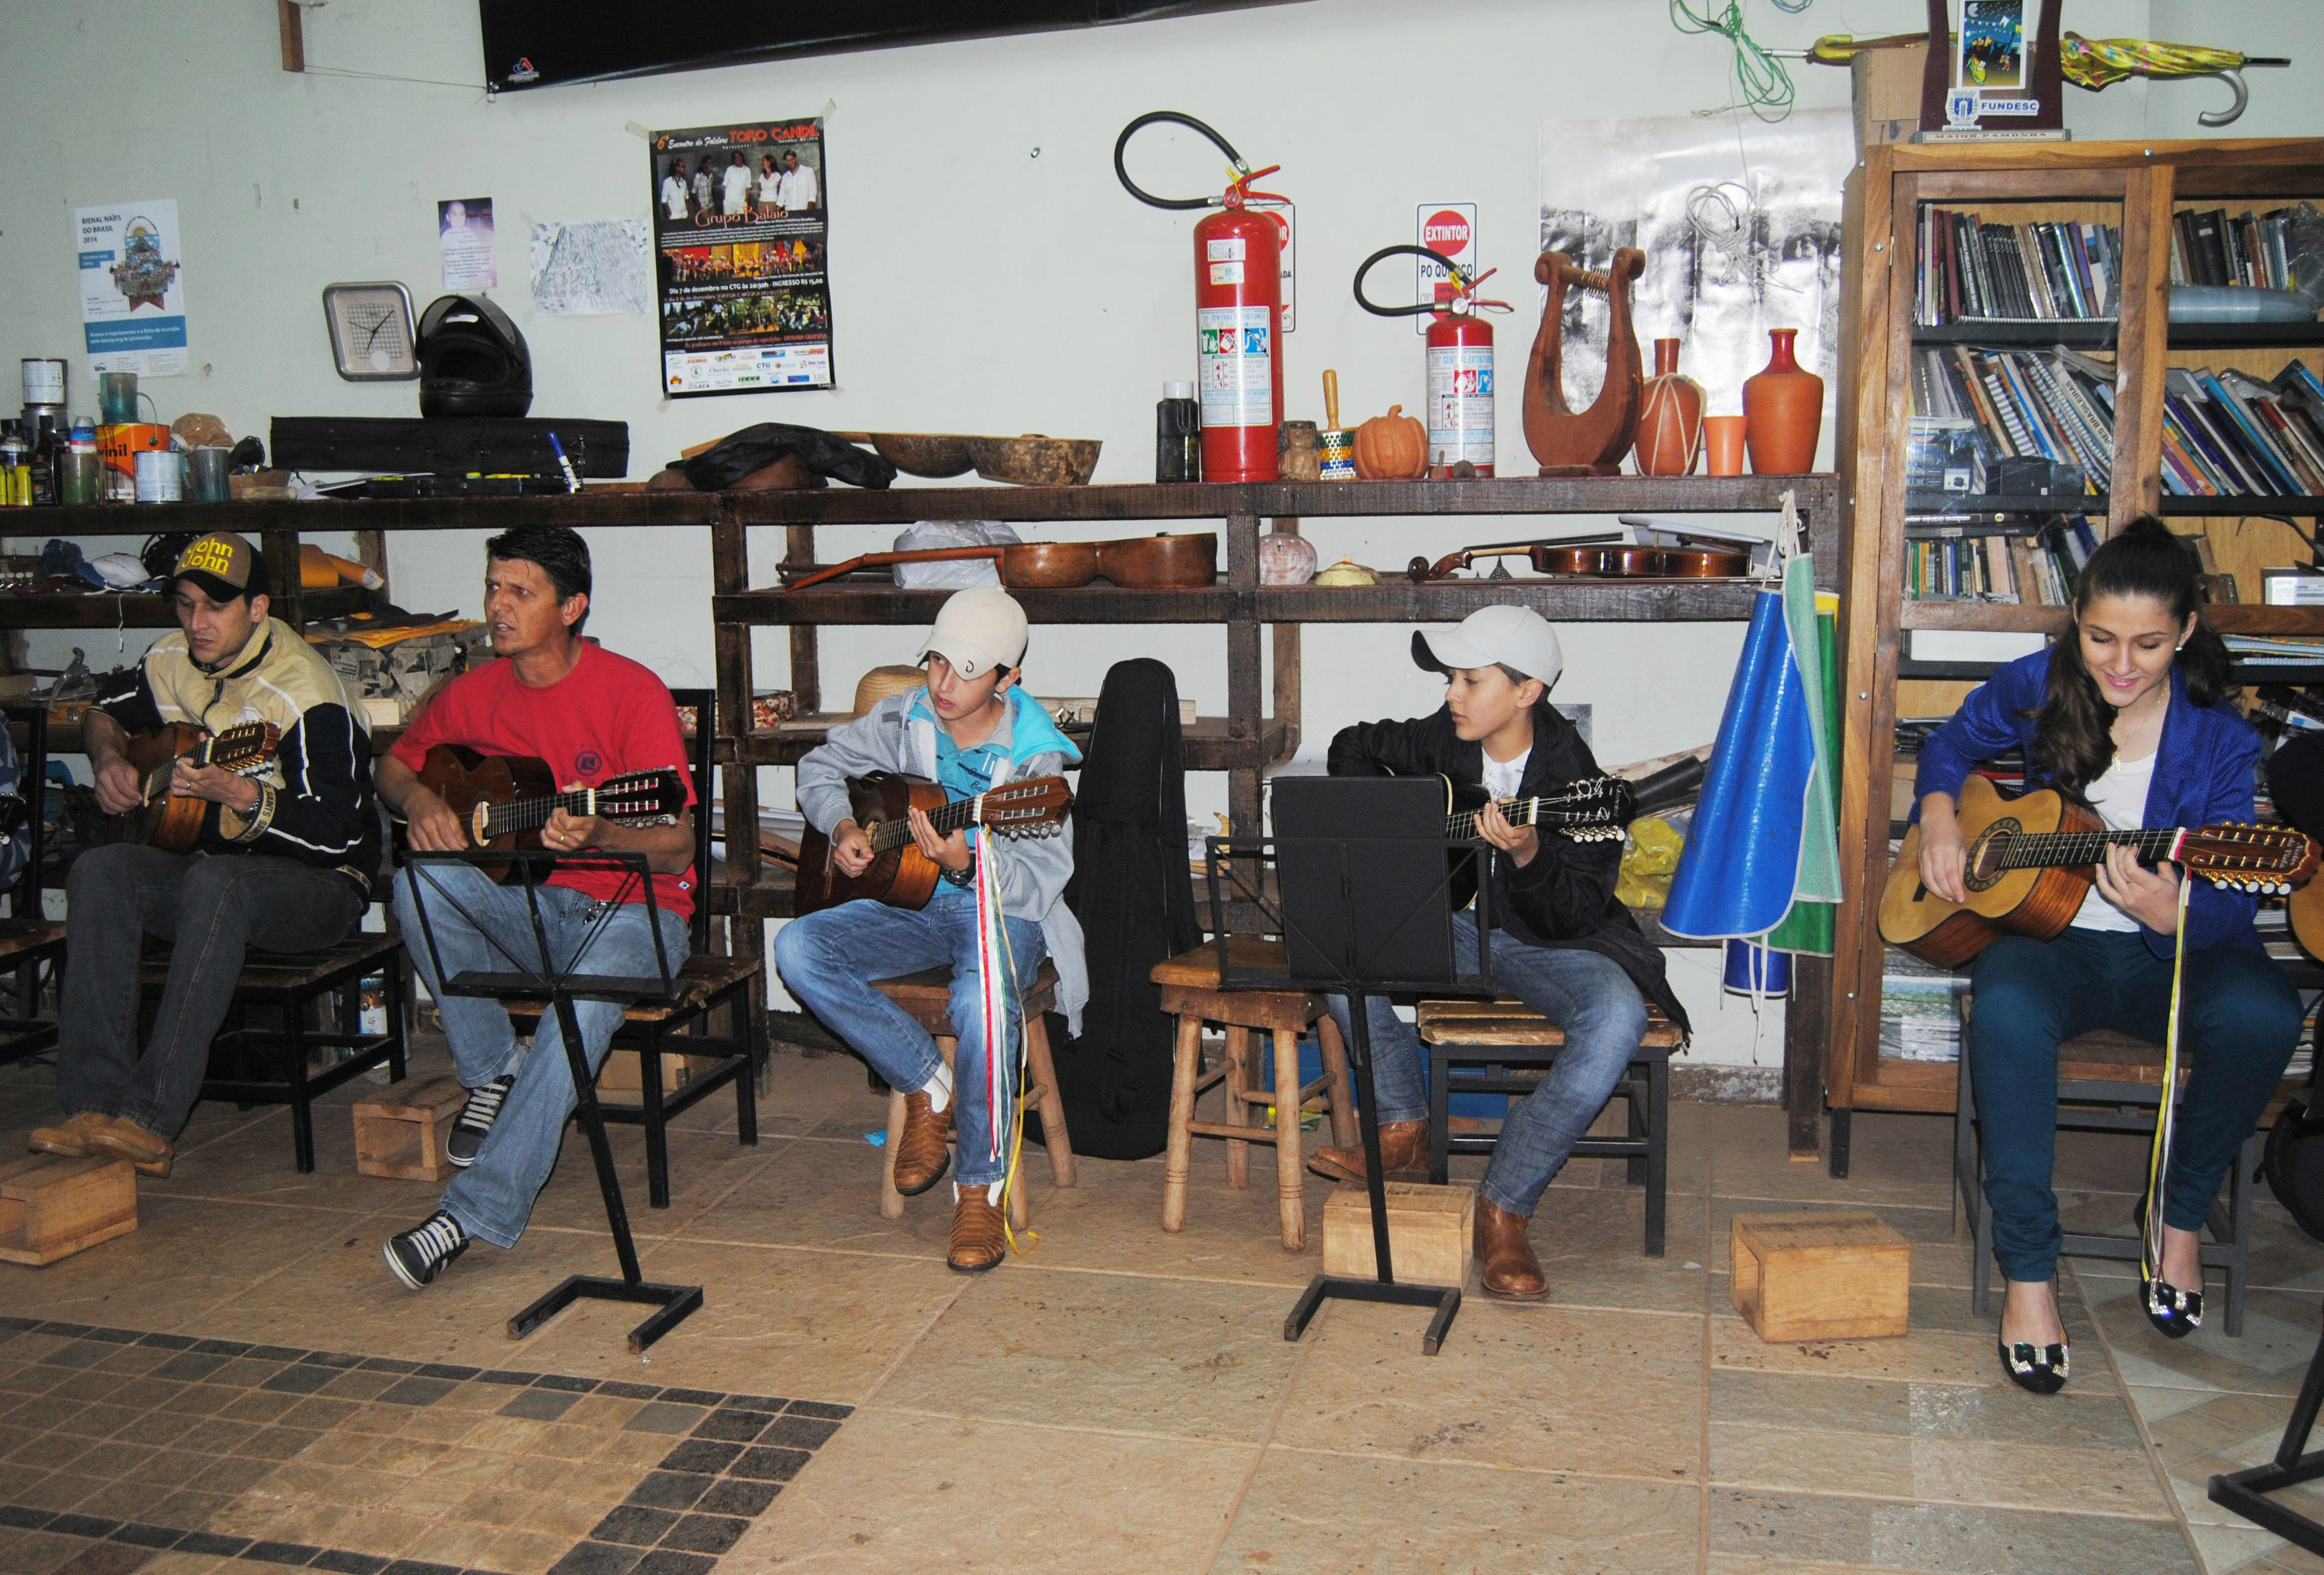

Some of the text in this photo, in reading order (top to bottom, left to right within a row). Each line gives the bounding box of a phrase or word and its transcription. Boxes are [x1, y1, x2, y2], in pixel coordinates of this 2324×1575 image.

[668, 139, 694, 149] Encontro
[729, 128, 767, 142] TORO
[82, 216, 102, 224] BIENAL
[695, 204, 788, 229] Grupo Balaio
[1425, 225, 1468, 242] EXTINTOR
[772, 279, 800, 287] INGRESSO
[2066, 380, 2100, 428] BRASILEIRAS
[187, 536, 234, 558] John
[182, 551, 229, 572] John
[263, 791, 273, 818] SAINTS
[2279, 849, 2292, 868] Viola
